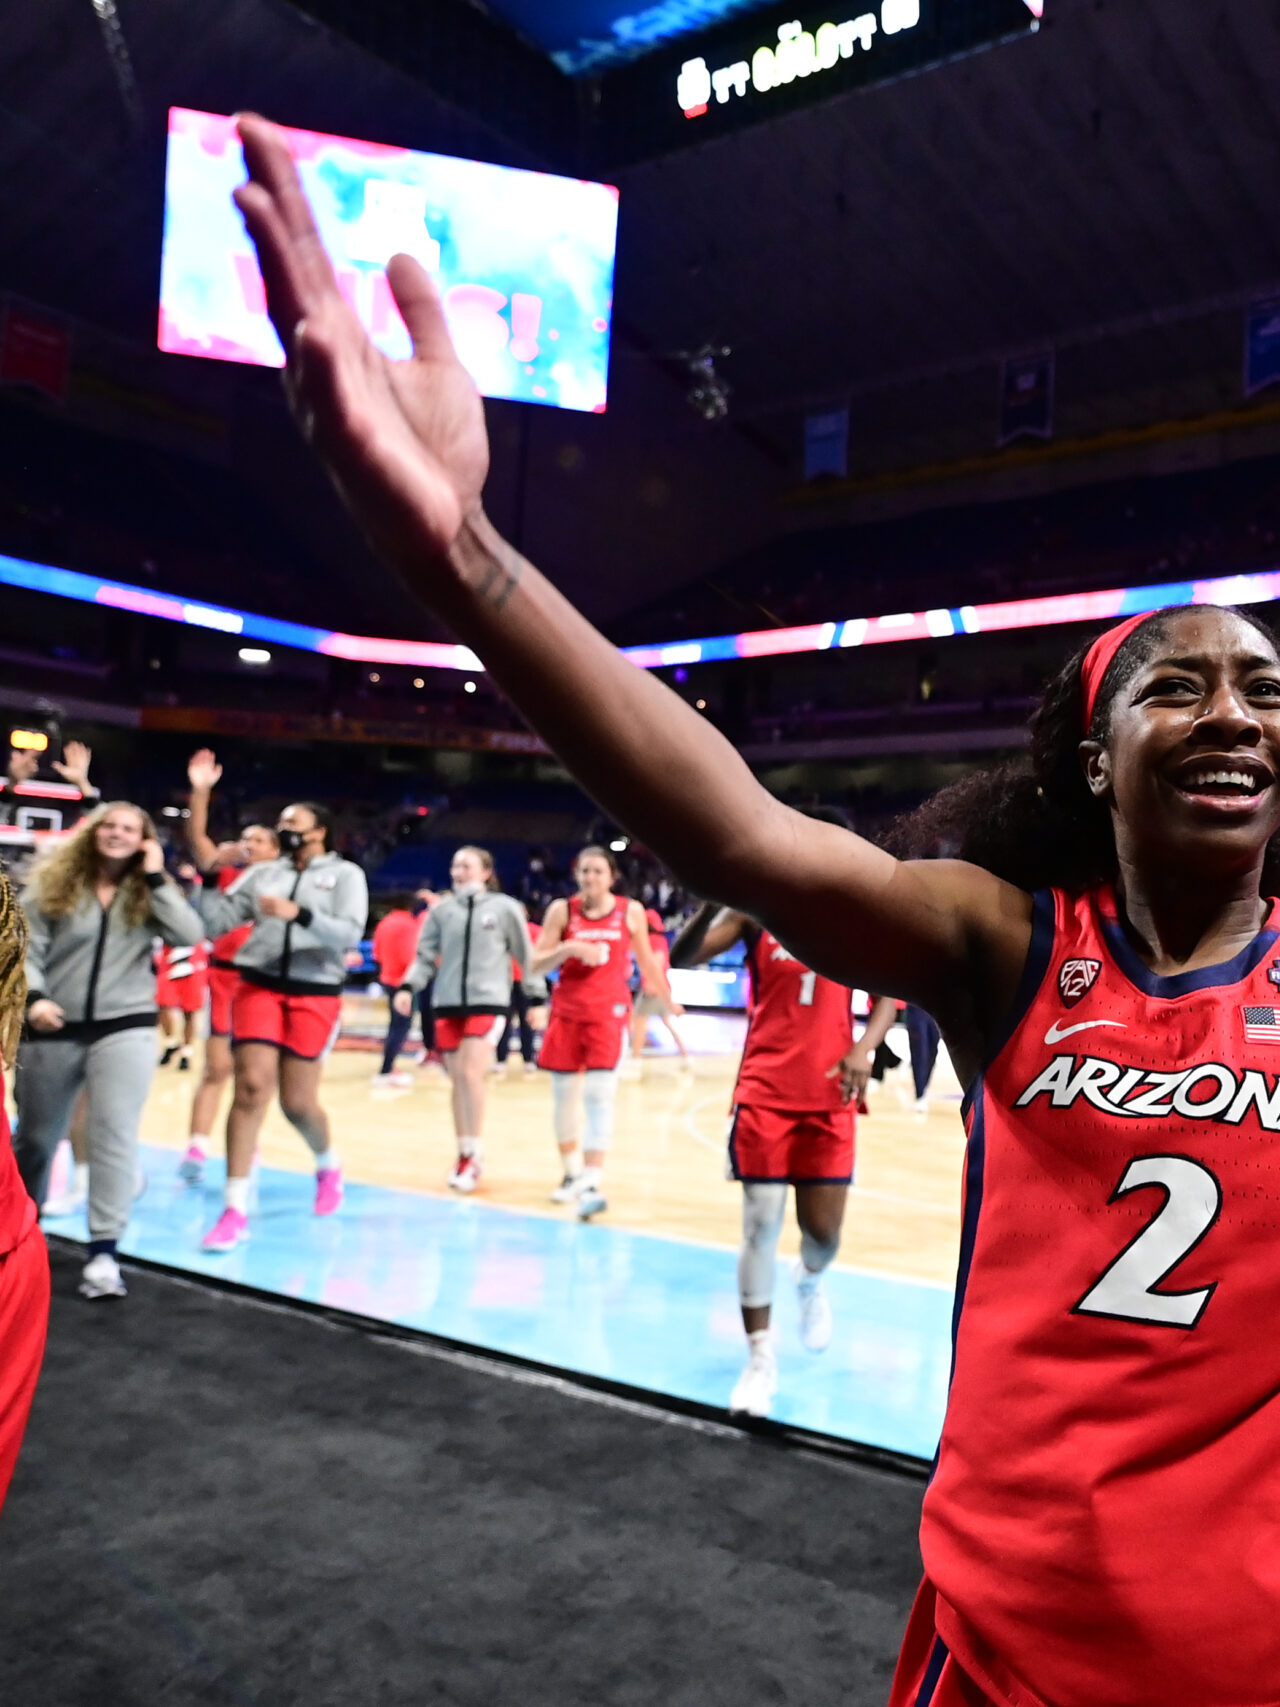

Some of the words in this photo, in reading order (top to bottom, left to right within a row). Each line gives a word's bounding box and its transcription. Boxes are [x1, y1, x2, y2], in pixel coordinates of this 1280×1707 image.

[1060, 960, 1099, 988] PAC
[1063, 977, 1082, 997] 12
[1070, 1152, 1225, 1330] 2
